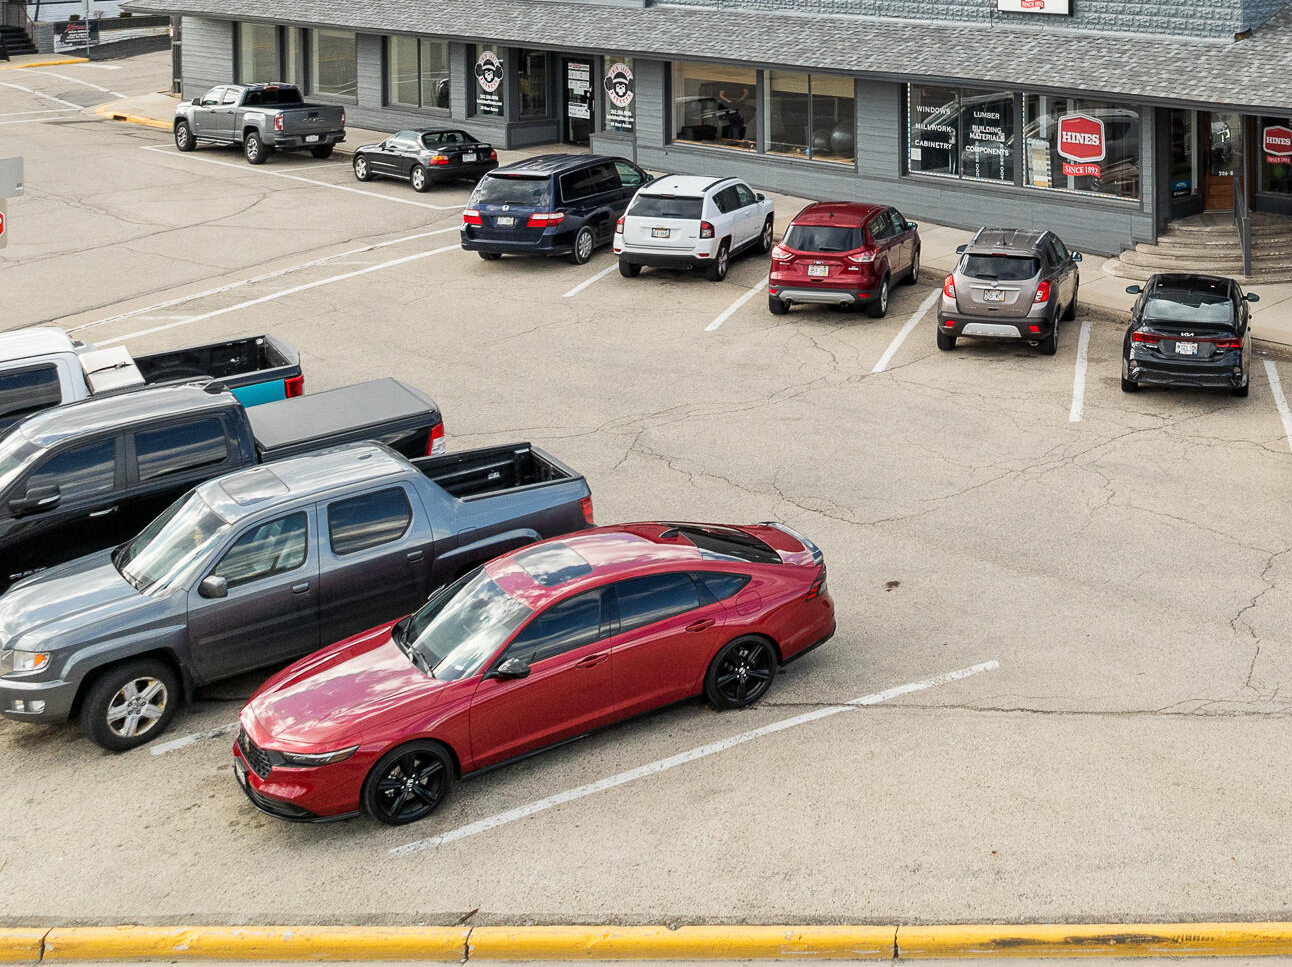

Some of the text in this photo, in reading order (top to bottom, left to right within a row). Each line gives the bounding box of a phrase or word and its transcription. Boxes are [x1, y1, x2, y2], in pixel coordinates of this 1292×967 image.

[916, 106, 951, 115] WINDOWS
[973, 111, 1000, 120] LUMBER
[915, 123, 952, 133] MILLWORK
[972, 125, 1002, 133] BUILDING
[969, 133, 1006, 142] MATERIALS
[1062, 131, 1100, 145] HINES
[1266, 136, 1291, 146] HINES
[914, 140, 952, 150] CABINETRY
[965, 145, 1010, 157] COMPONENTS
[1065, 165, 1098, 175] SINCE 1892
